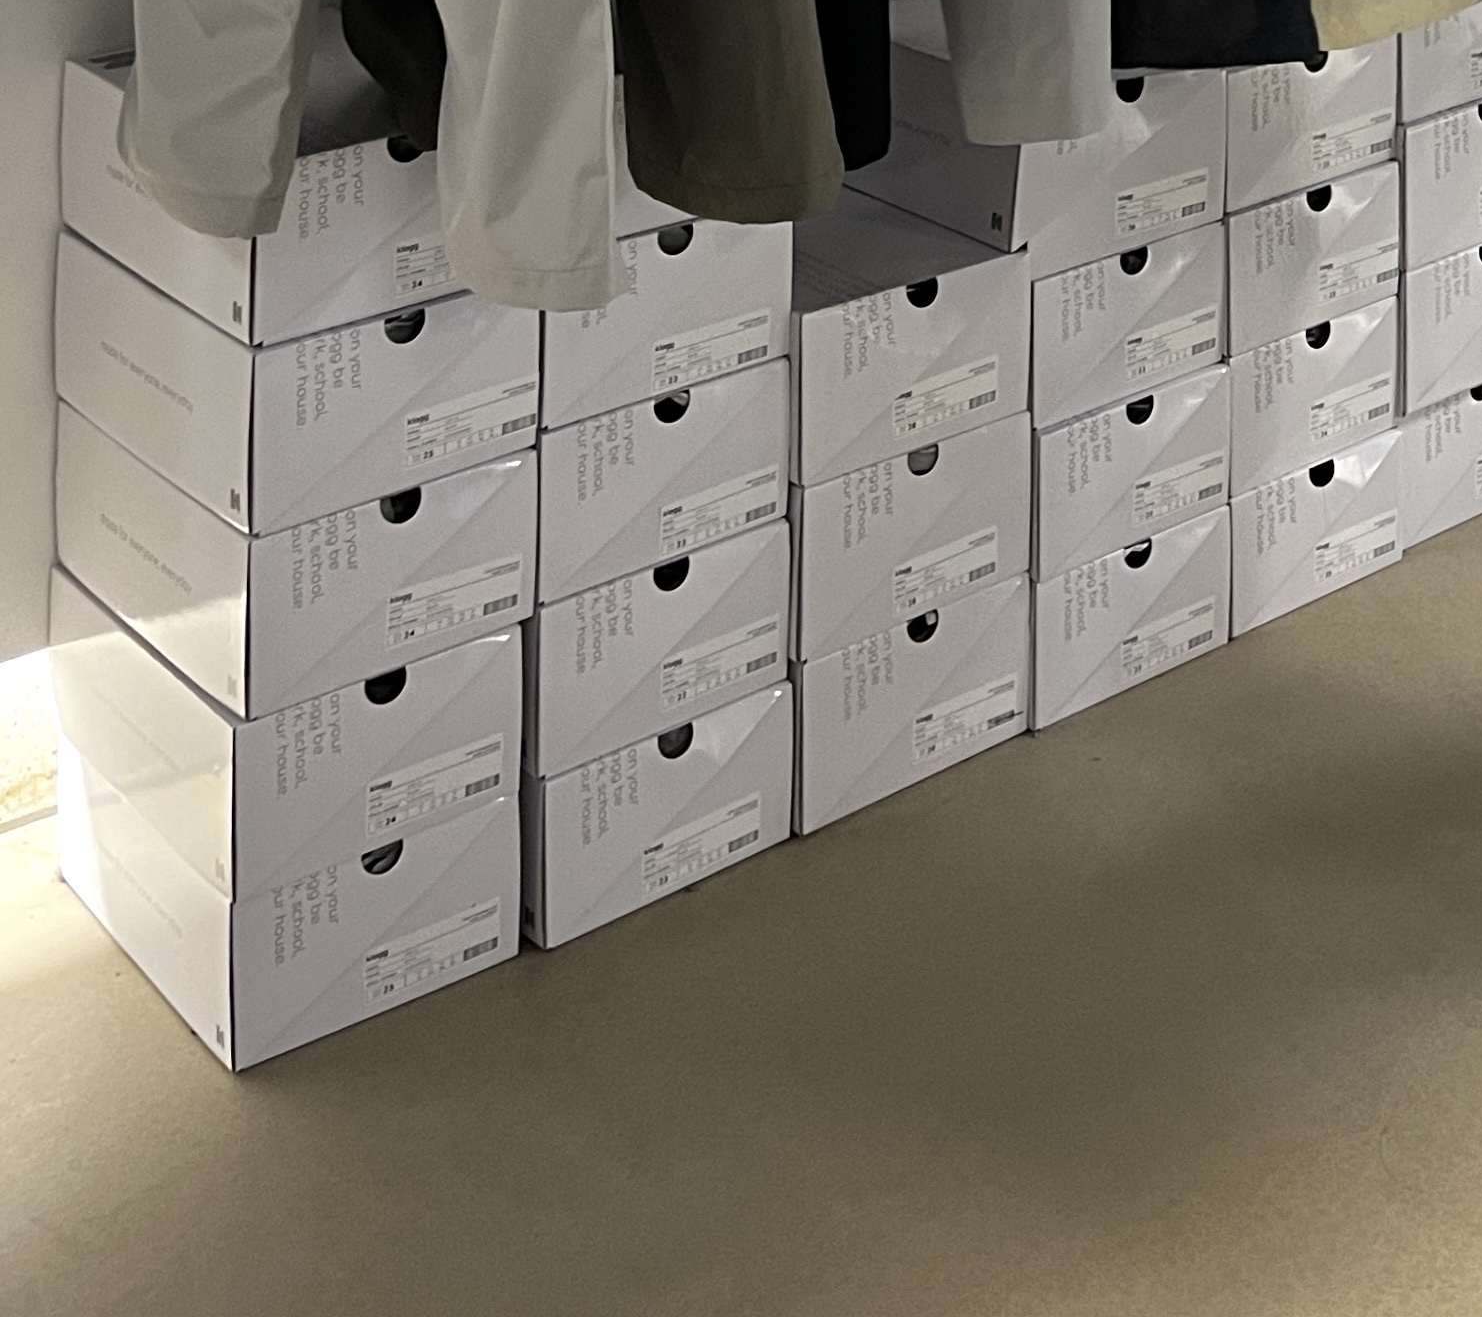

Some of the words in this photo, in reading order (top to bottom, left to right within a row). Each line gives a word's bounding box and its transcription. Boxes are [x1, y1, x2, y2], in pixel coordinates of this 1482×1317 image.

[353, 146, 364, 167] on
[351, 170, 364, 205] your
[350, 329, 360, 351] on
[348, 353, 361, 389] your
[346, 510, 356, 533] on
[343, 535, 357, 570] your
[328, 718, 341, 755] your
